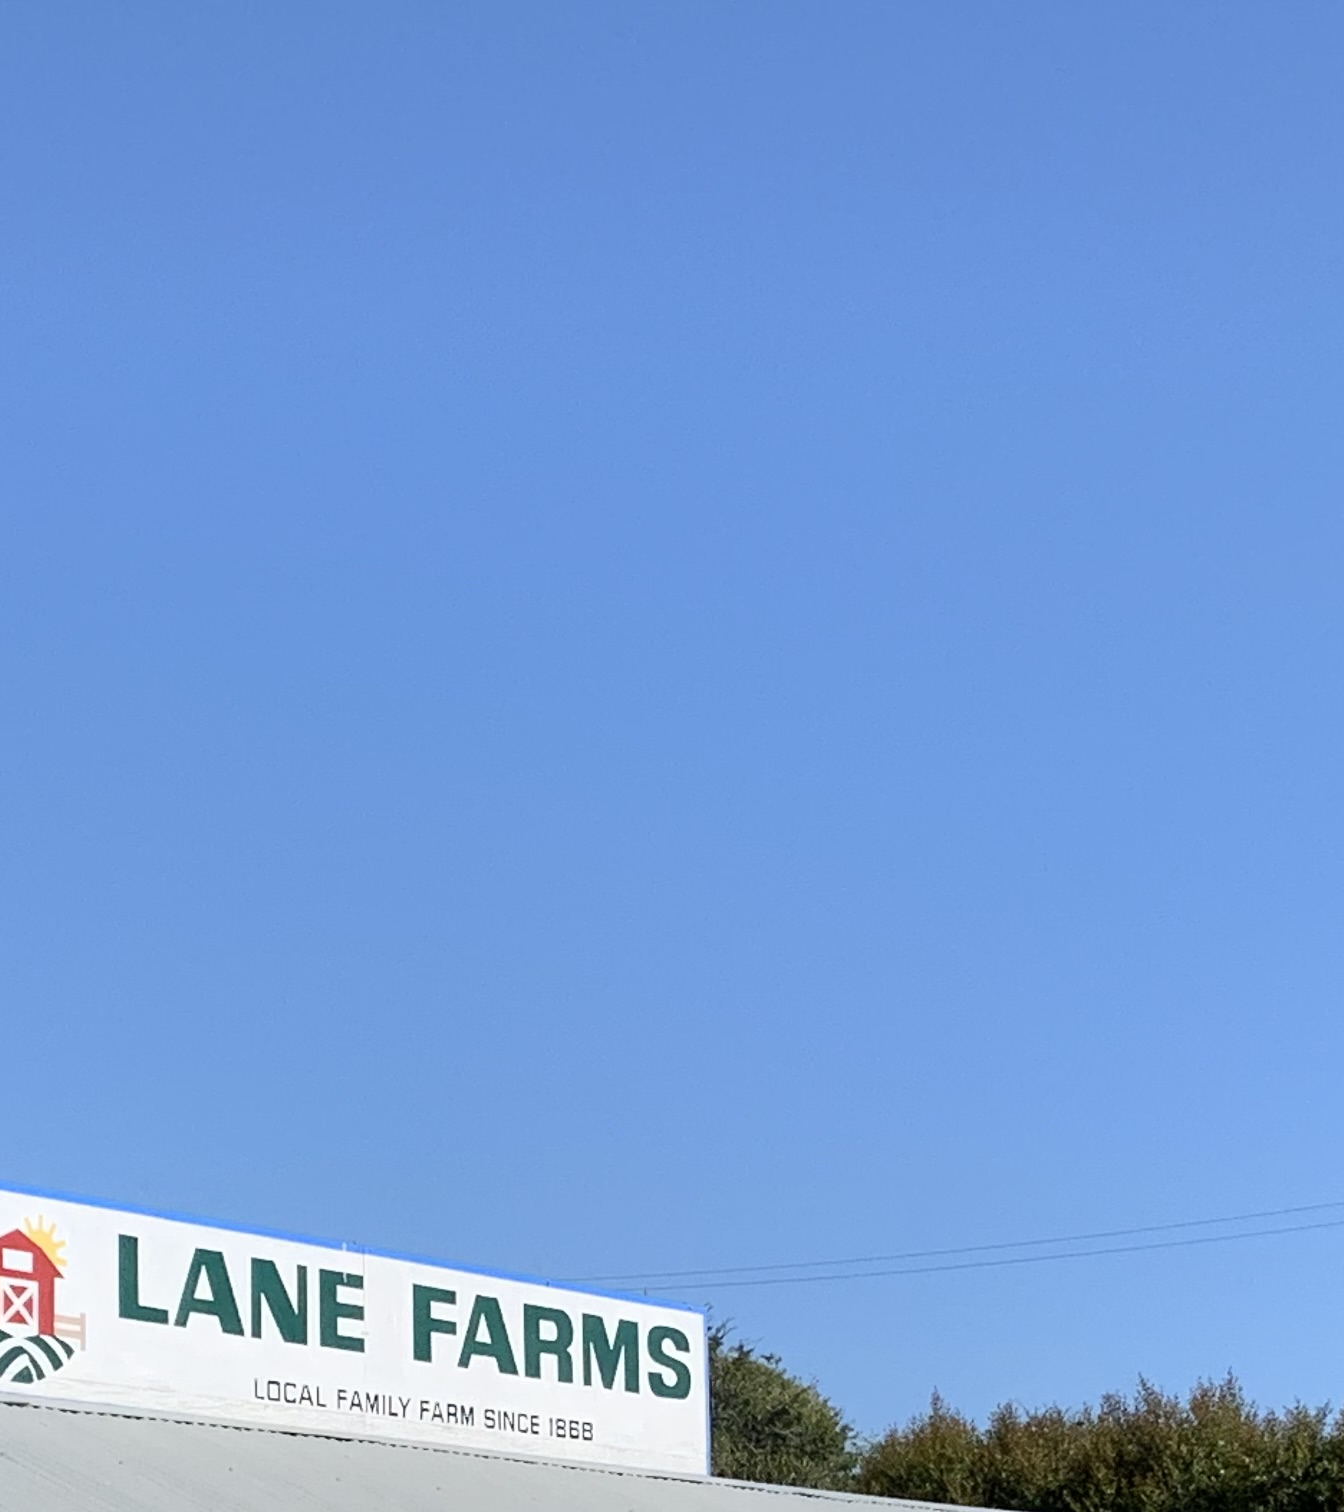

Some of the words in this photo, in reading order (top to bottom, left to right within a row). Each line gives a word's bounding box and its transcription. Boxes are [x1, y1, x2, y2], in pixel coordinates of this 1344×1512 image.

[117, 1234, 366, 1354] LANE
[411, 1283, 693, 1400] FARMS
[254, 1378, 327, 1408] LOCAL
[337, 1389, 411, 1418] FAMILY
[420, 1400, 475, 1427] FARM
[484, 1408, 540, 1435] SINCE
[549, 1417, 594, 1442] 1868
